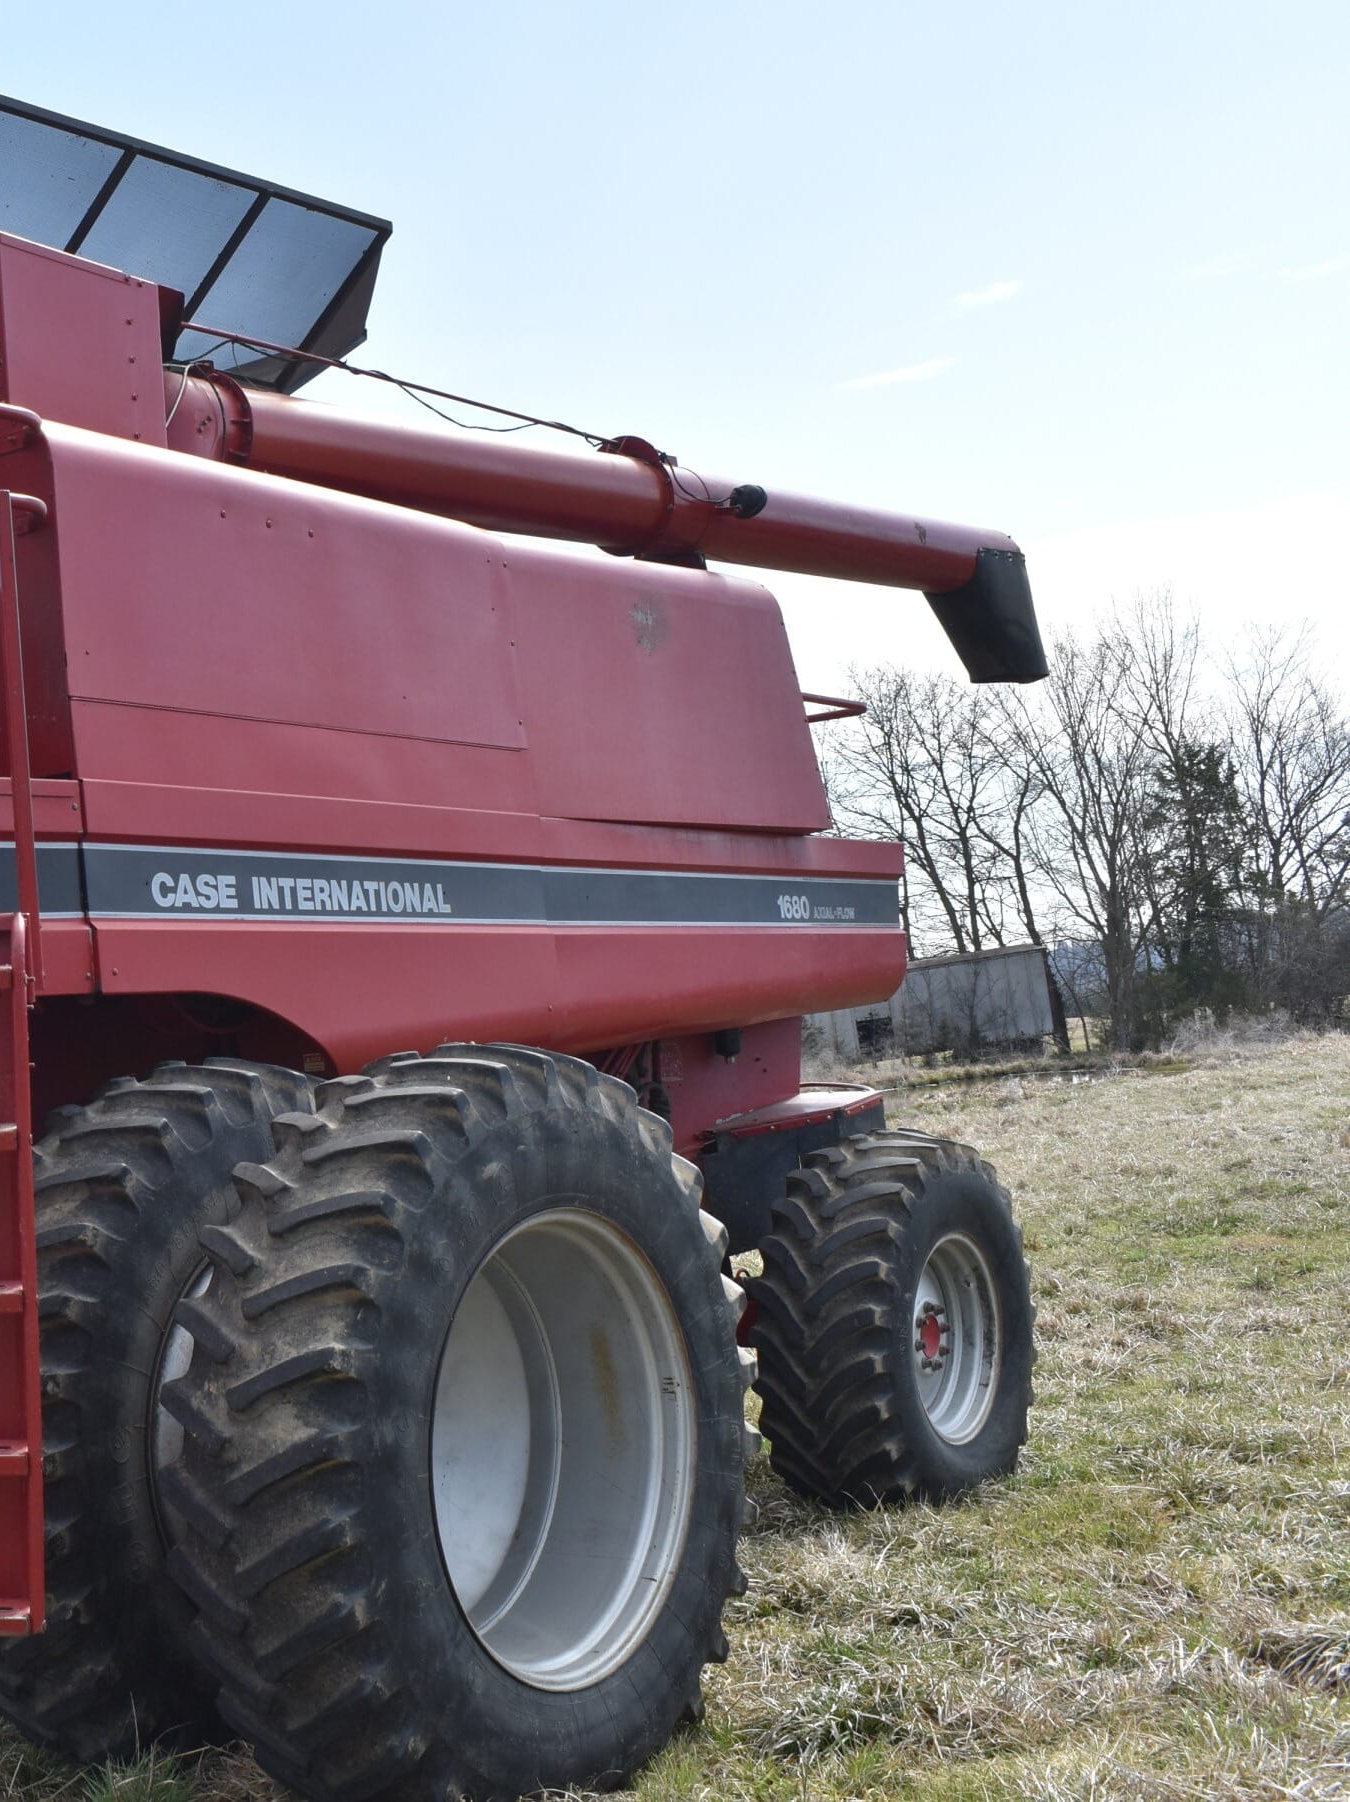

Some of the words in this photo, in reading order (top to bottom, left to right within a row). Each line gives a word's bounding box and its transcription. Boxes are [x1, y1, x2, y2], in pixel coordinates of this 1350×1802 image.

[151, 872, 239, 908] CASE
[251, 876, 452, 913] INTERNATIONAL
[777, 895, 810, 920] 1680
[813, 906, 856, 920] AXIAL-FLOW
